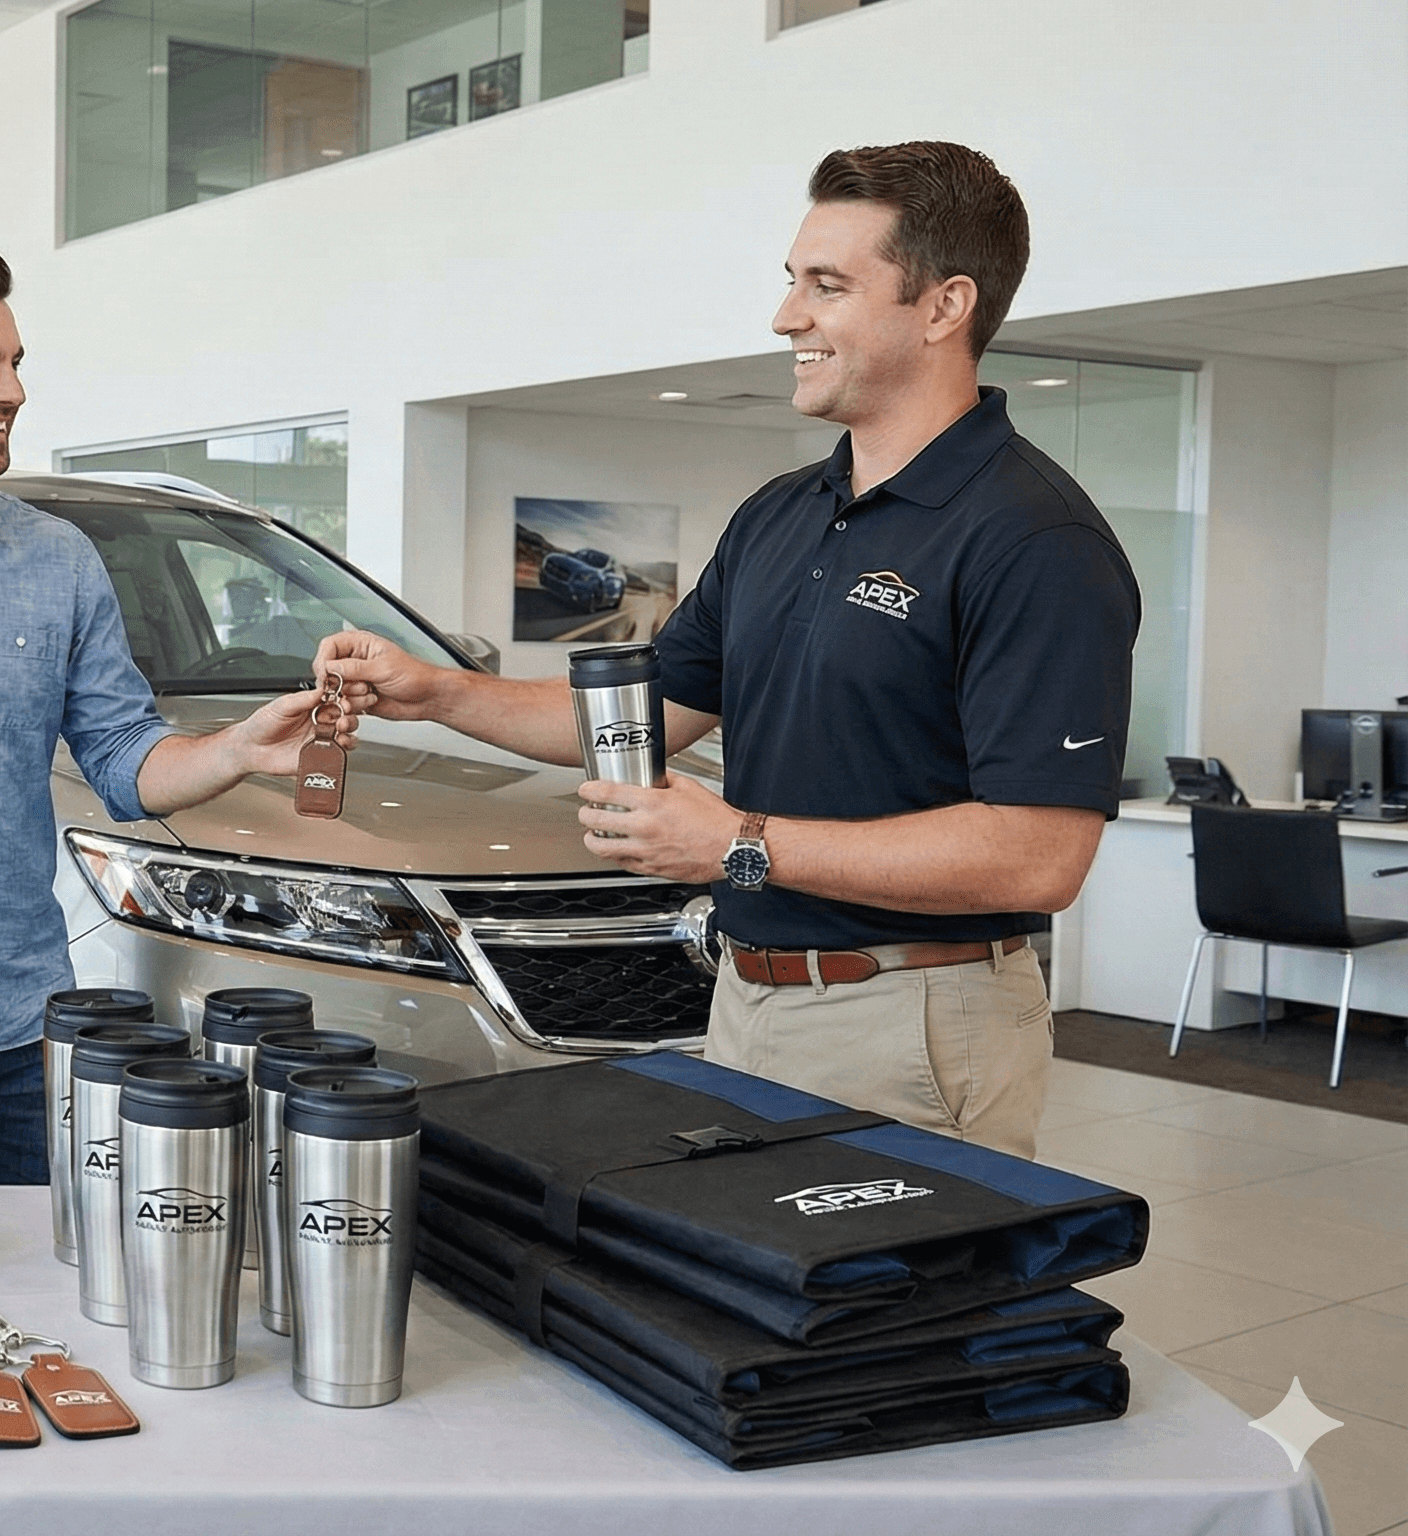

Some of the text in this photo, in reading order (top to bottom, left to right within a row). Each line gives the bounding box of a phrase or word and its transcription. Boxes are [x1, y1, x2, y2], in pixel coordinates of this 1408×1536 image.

[849, 580, 916, 614] APEX
[594, 727, 655, 748] APEX
[795, 1181, 927, 1212] APEX
[137, 1201, 226, 1224] APEX
[299, 1212, 392, 1237] APEX
